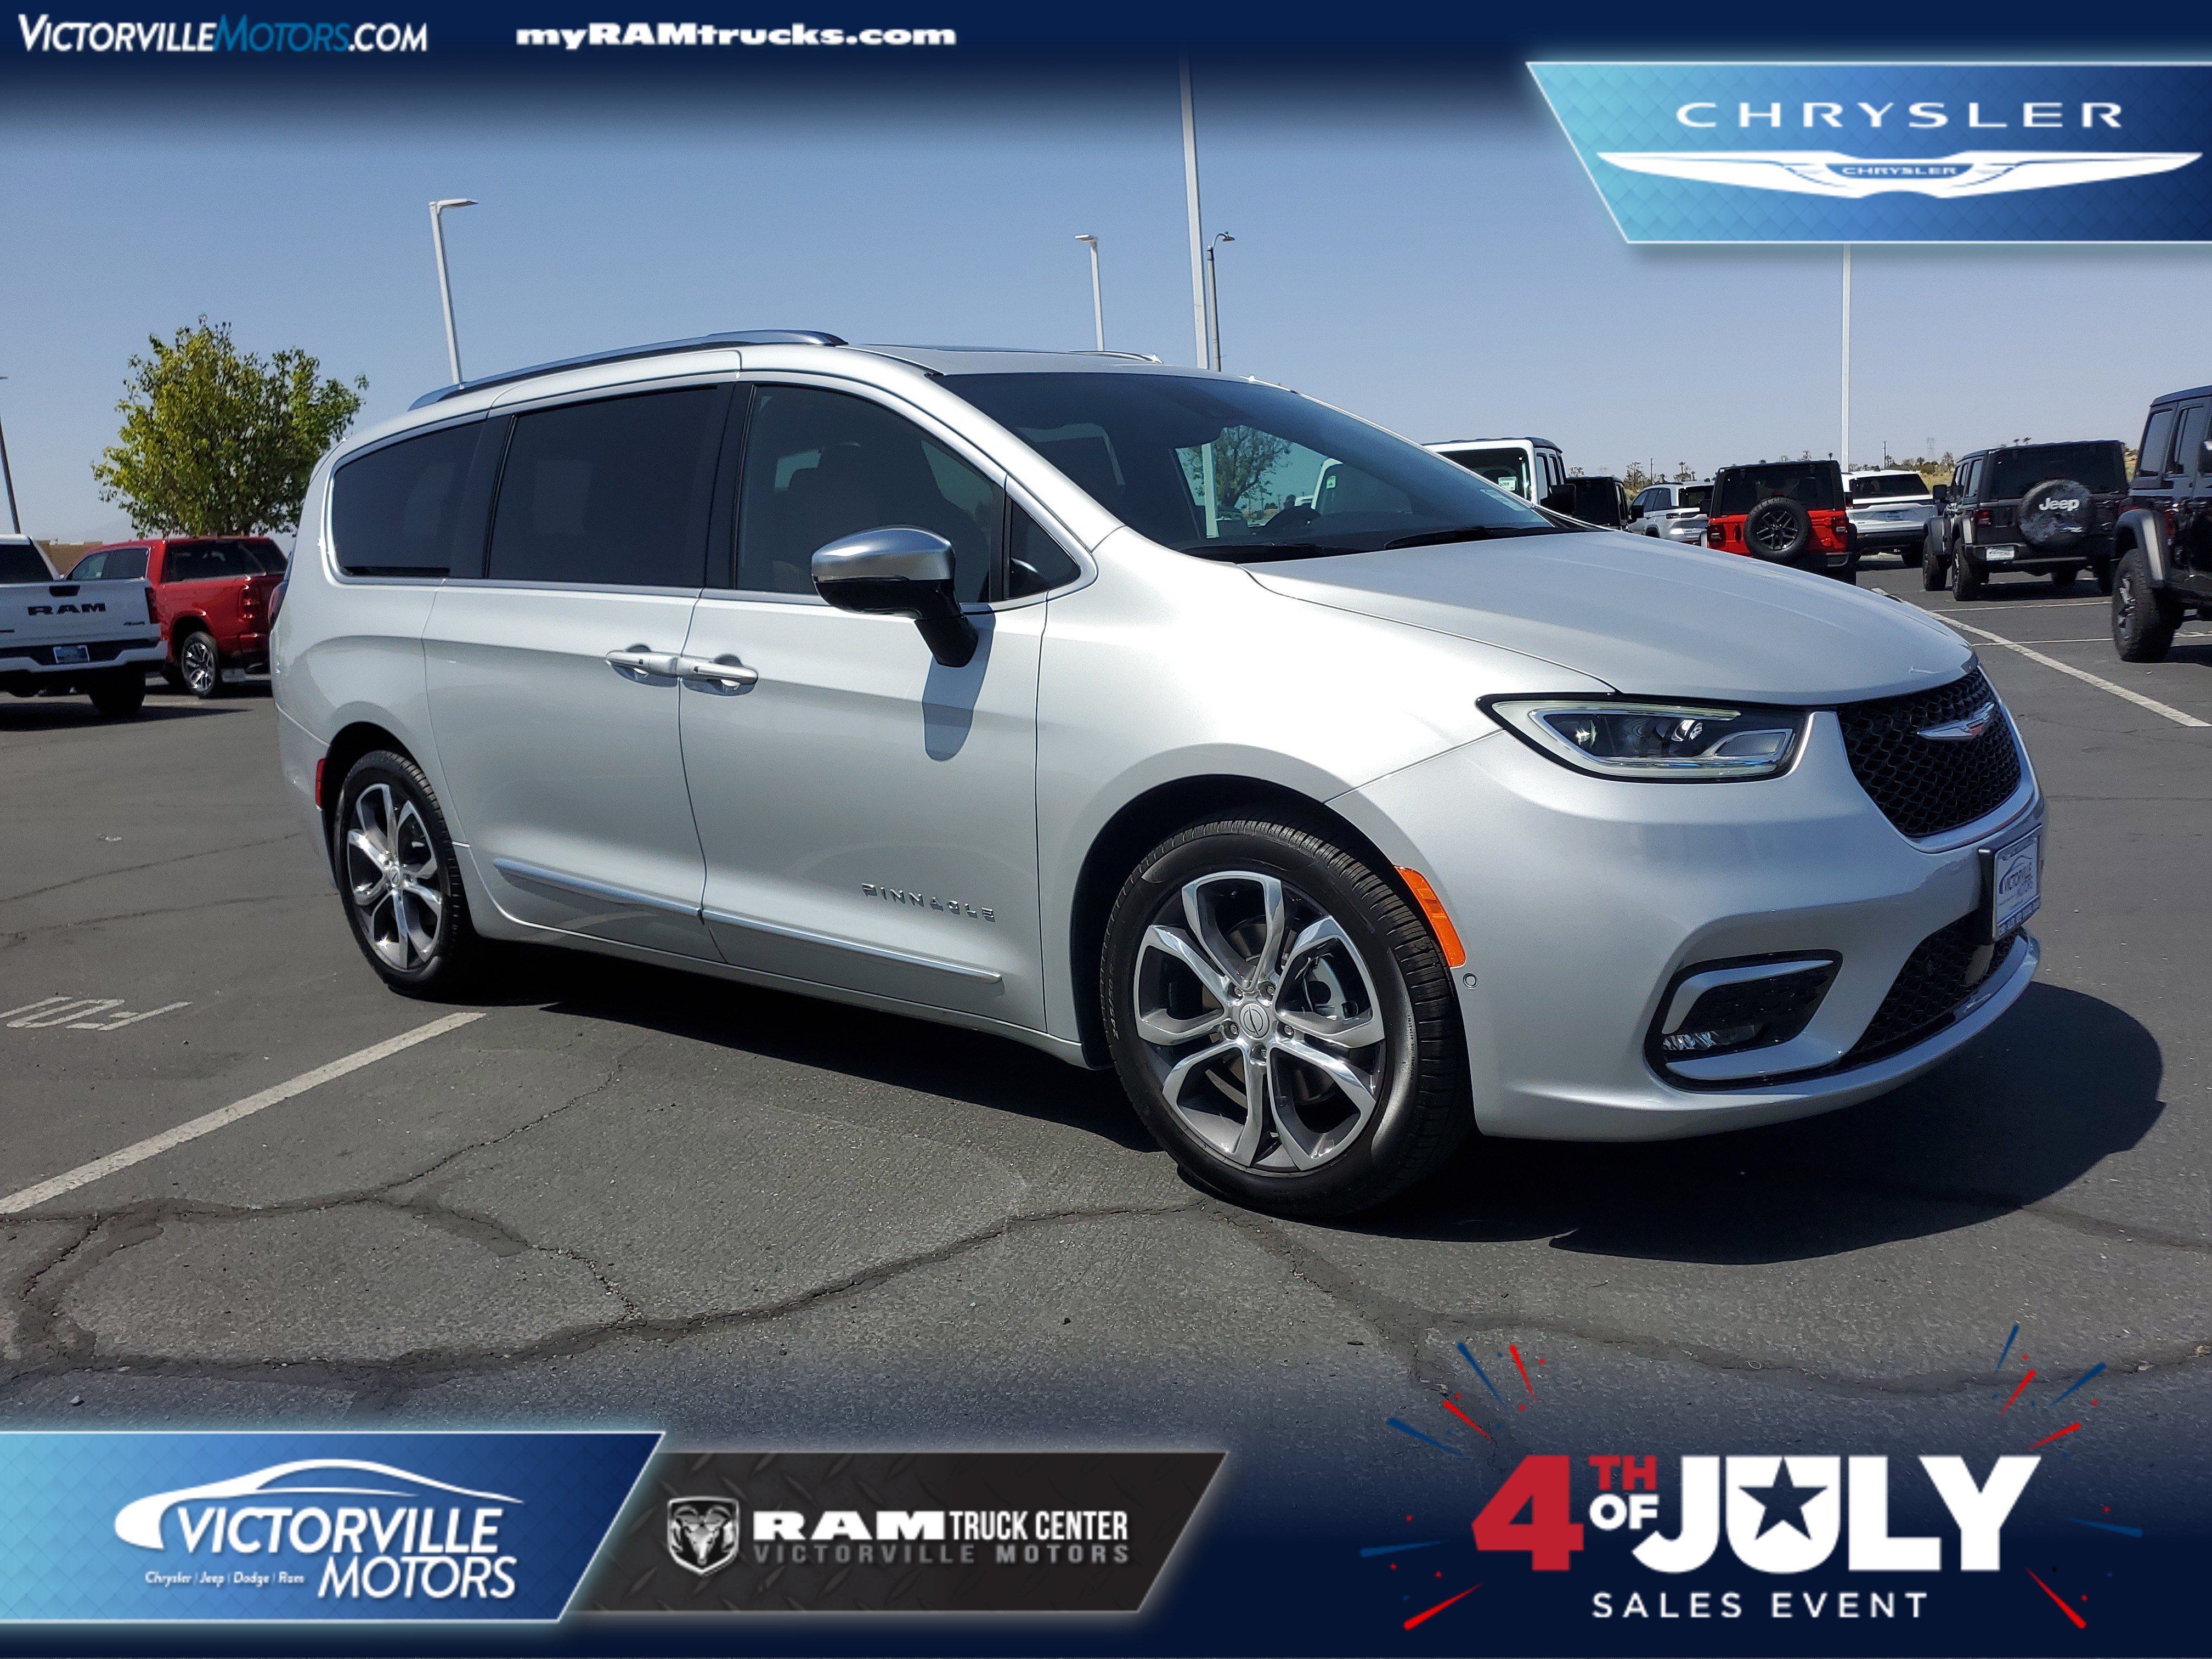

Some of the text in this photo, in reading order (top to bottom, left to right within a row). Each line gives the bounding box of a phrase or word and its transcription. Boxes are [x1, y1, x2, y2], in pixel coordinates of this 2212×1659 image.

[2039, 497, 2080, 511] Jeep
[28, 603, 106, 616] RAM
[861, 882, 995, 922] PINNACLE
